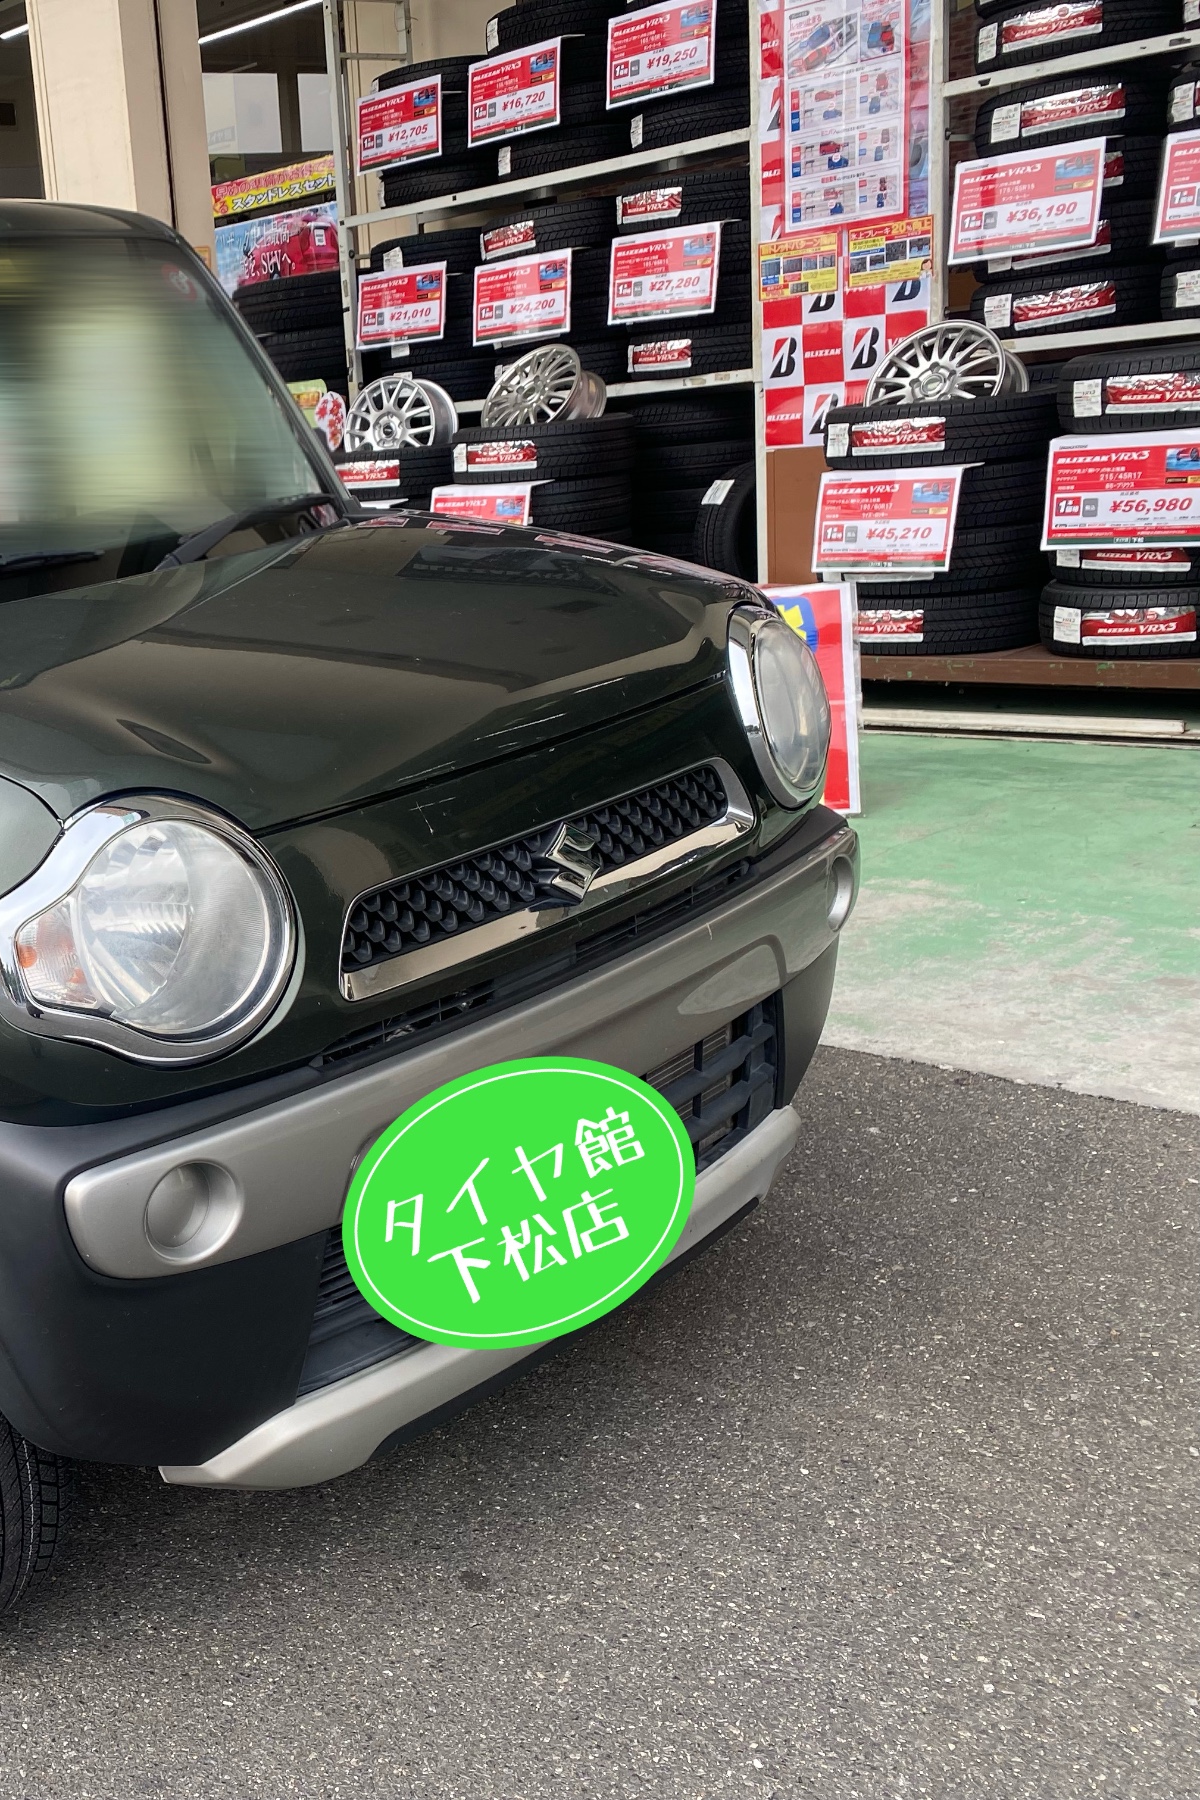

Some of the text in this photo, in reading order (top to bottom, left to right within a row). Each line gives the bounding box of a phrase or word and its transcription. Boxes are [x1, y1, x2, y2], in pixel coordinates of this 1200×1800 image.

[1051, 16, 1085, 31] VRX3
[647, 47, 698, 69] ¥19,250
[502, 91, 545, 111] ¥16,720
[1074, 100, 1110, 115] VRX3
[388, 124, 428, 142] ¥12,705
[963, 163, 1042, 185] BLIZZAK VRX3
[646, 202, 669, 212] VRX3
[1006, 201, 1078, 223] ¥36,190
[648, 241, 674, 253] VRX3
[649, 276, 700, 292] ¥27,280
[509, 298, 556, 315] ¥24,200
[1066, 297, 1100, 312] VRX3
[390, 307, 431, 322] ¥21,010
[656, 352, 679, 362] VRX3
[805, 348, 842, 358] BLIZZAK
[766, 413, 802, 422] BLIZZAK
[895, 432, 928, 444] VRX3
[499, 453, 523, 462] VRX3
[1057, 450, 1150, 465] BLIZZAK VRX3
[365, 472, 387, 480] VRX3
[826, 484, 900, 495] BLIZZAK VRX3
[1109, 497, 1193, 514] ¥56,980
[866, 526, 932, 541] ¥45,210
[1135, 551, 1173, 560] VRX3
[876, 623, 906, 632] VRX3
[1139, 621, 1177, 633] VRX3
